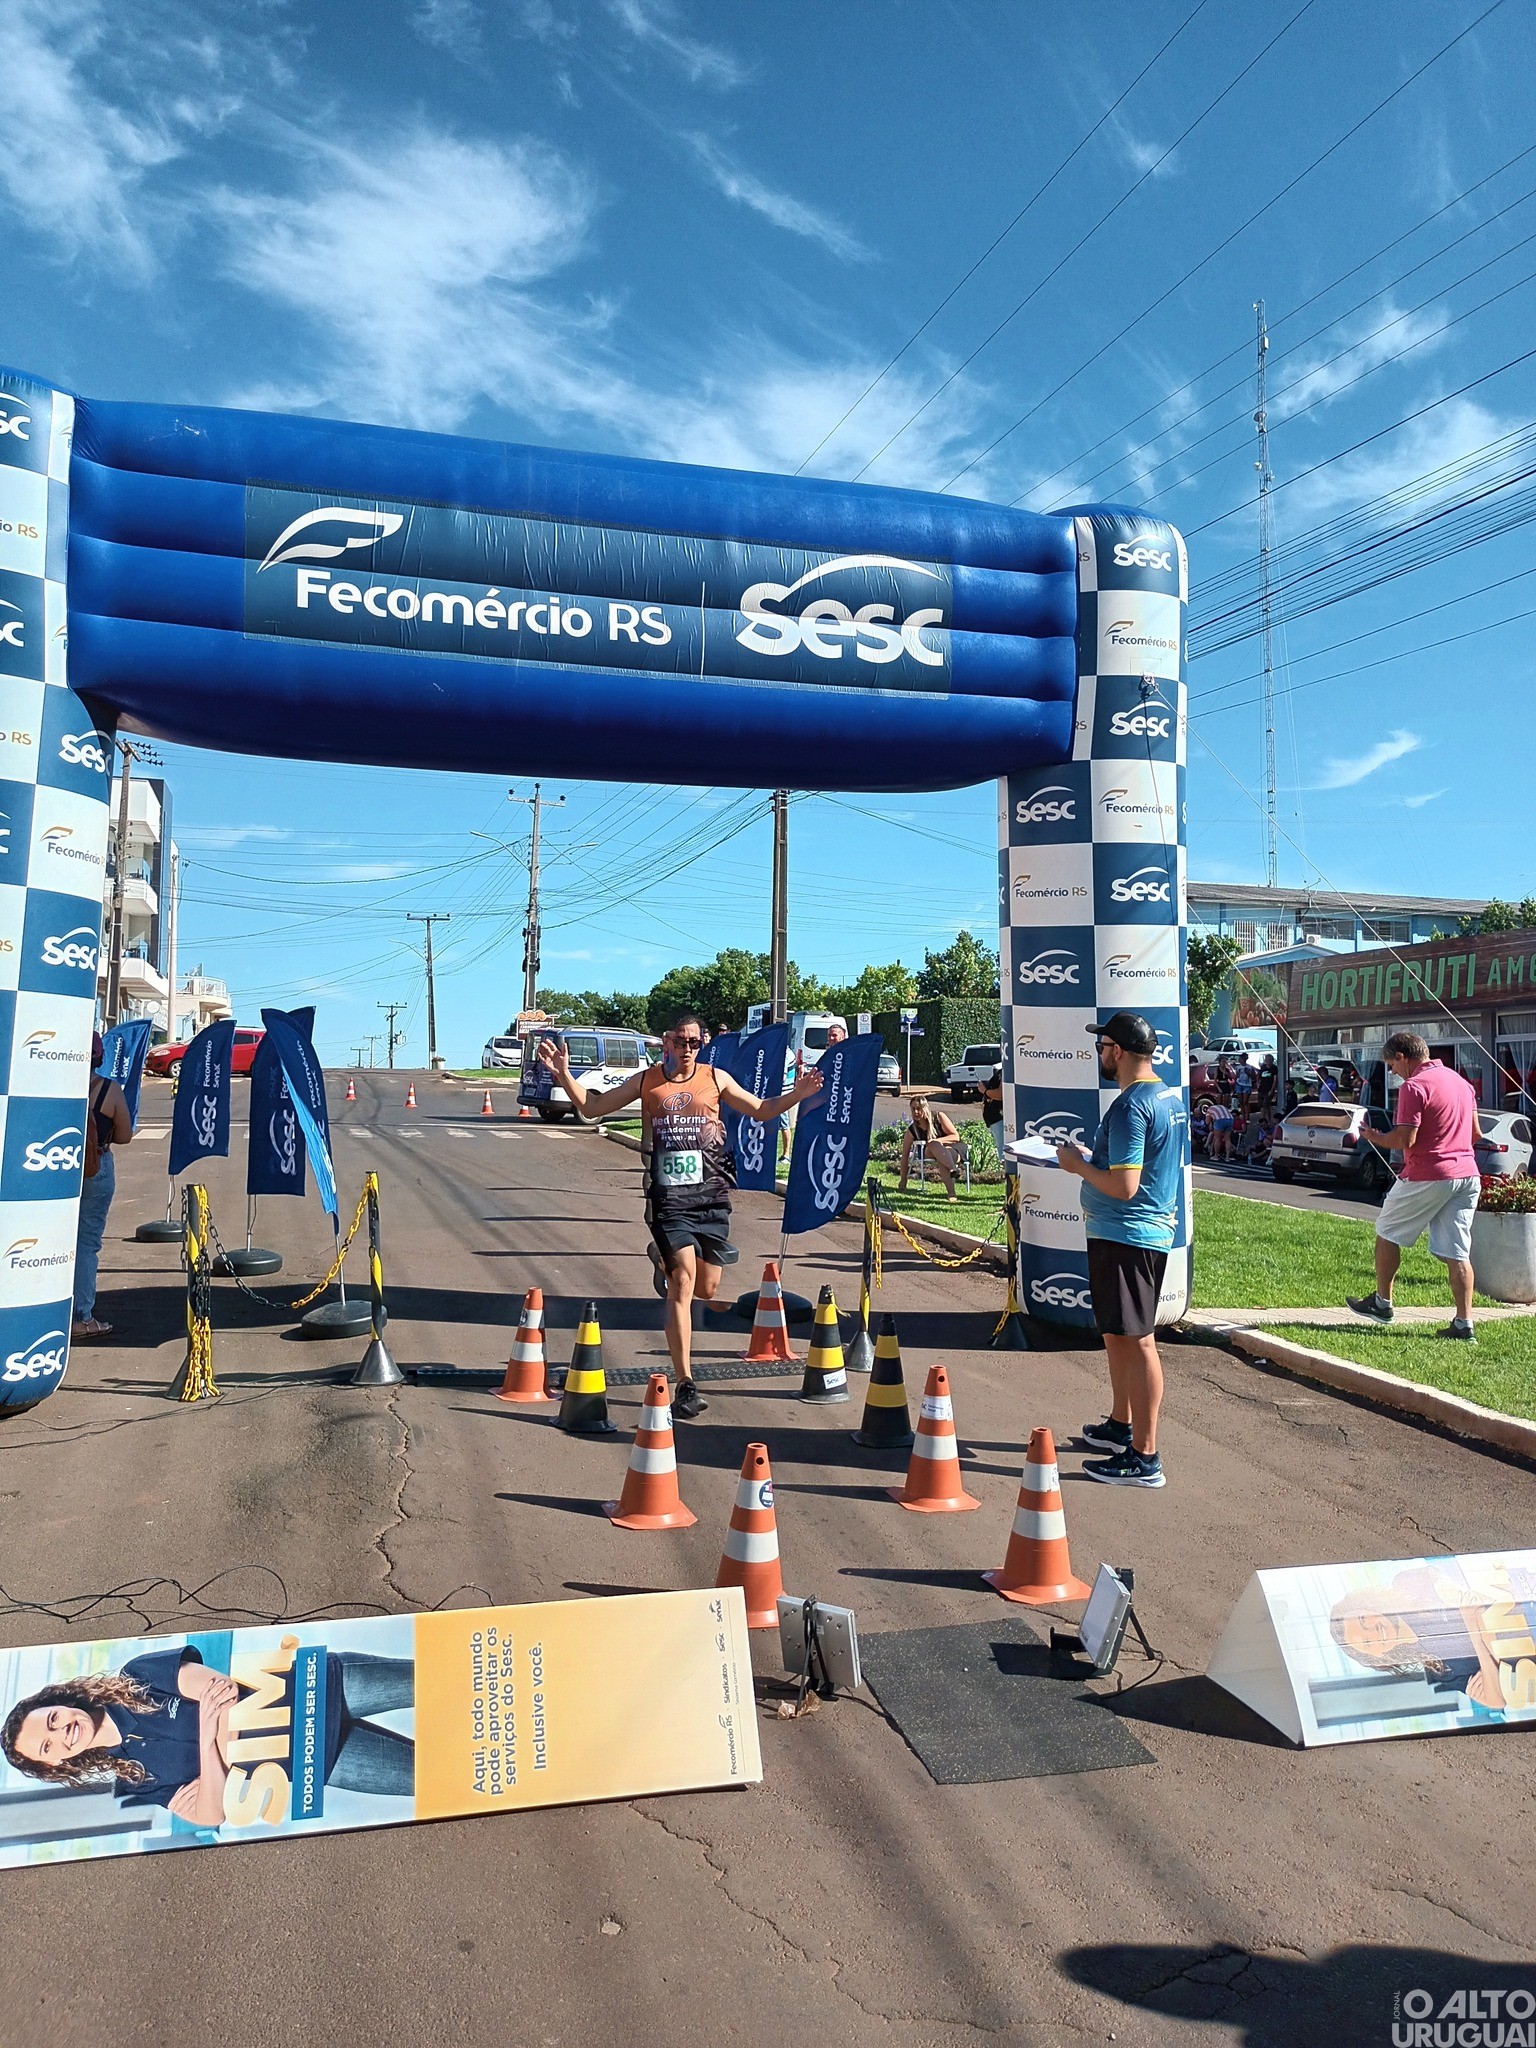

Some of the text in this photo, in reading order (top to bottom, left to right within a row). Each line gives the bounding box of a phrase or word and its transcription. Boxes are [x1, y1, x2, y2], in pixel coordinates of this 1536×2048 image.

[17, 523, 39, 539] RS
[297, 568, 673, 646] Fecomércio RS
[1112, 635, 1177, 650] Fecomércio RS
[11, 731, 32, 746] RS
[1106, 802, 1174, 815] Fecomércio RS
[48, 842, 101, 866] Fecomércio
[1015, 887, 1069, 898] Fecomércio
[1071, 886, 1088, 896] RS
[1110, 967, 1177, 978] Fecomércio RS
[1301, 953, 1477, 1012] HORTIFRUTI
[30, 1048, 85, 1062] Fecomércio
[1019, 1047, 1073, 1059] Fecomércio
[1076, 1051, 1092, 1060] RS
[1151, 1044, 1174, 1065] sc
[826, 1052, 844, 1122] Fecomércio
[841, 1086, 853, 1124] Senac
[673, 1114, 708, 1124] Forma
[662, 1155, 698, 1175] 558
[1025, 1206, 1080, 1223] Fecomércio
[11, 1252, 69, 1270] Fecomércio
[1120, 1466, 1141, 1476] FILA
[722, 1662, 731, 1704] Sindicatos
[470, 1631, 488, 1793] Aqui, todo mundo
[485, 1626, 504, 1795] pode aproveitar os
[500, 1633, 517, 1785] serviços do Sesc.
[528, 1641, 547, 1769] Inclusive você.
[302, 1652, 318, 1814] TODOS PODEM SER SESC.
[725, 1714, 738, 1775] Fecomércio RS
